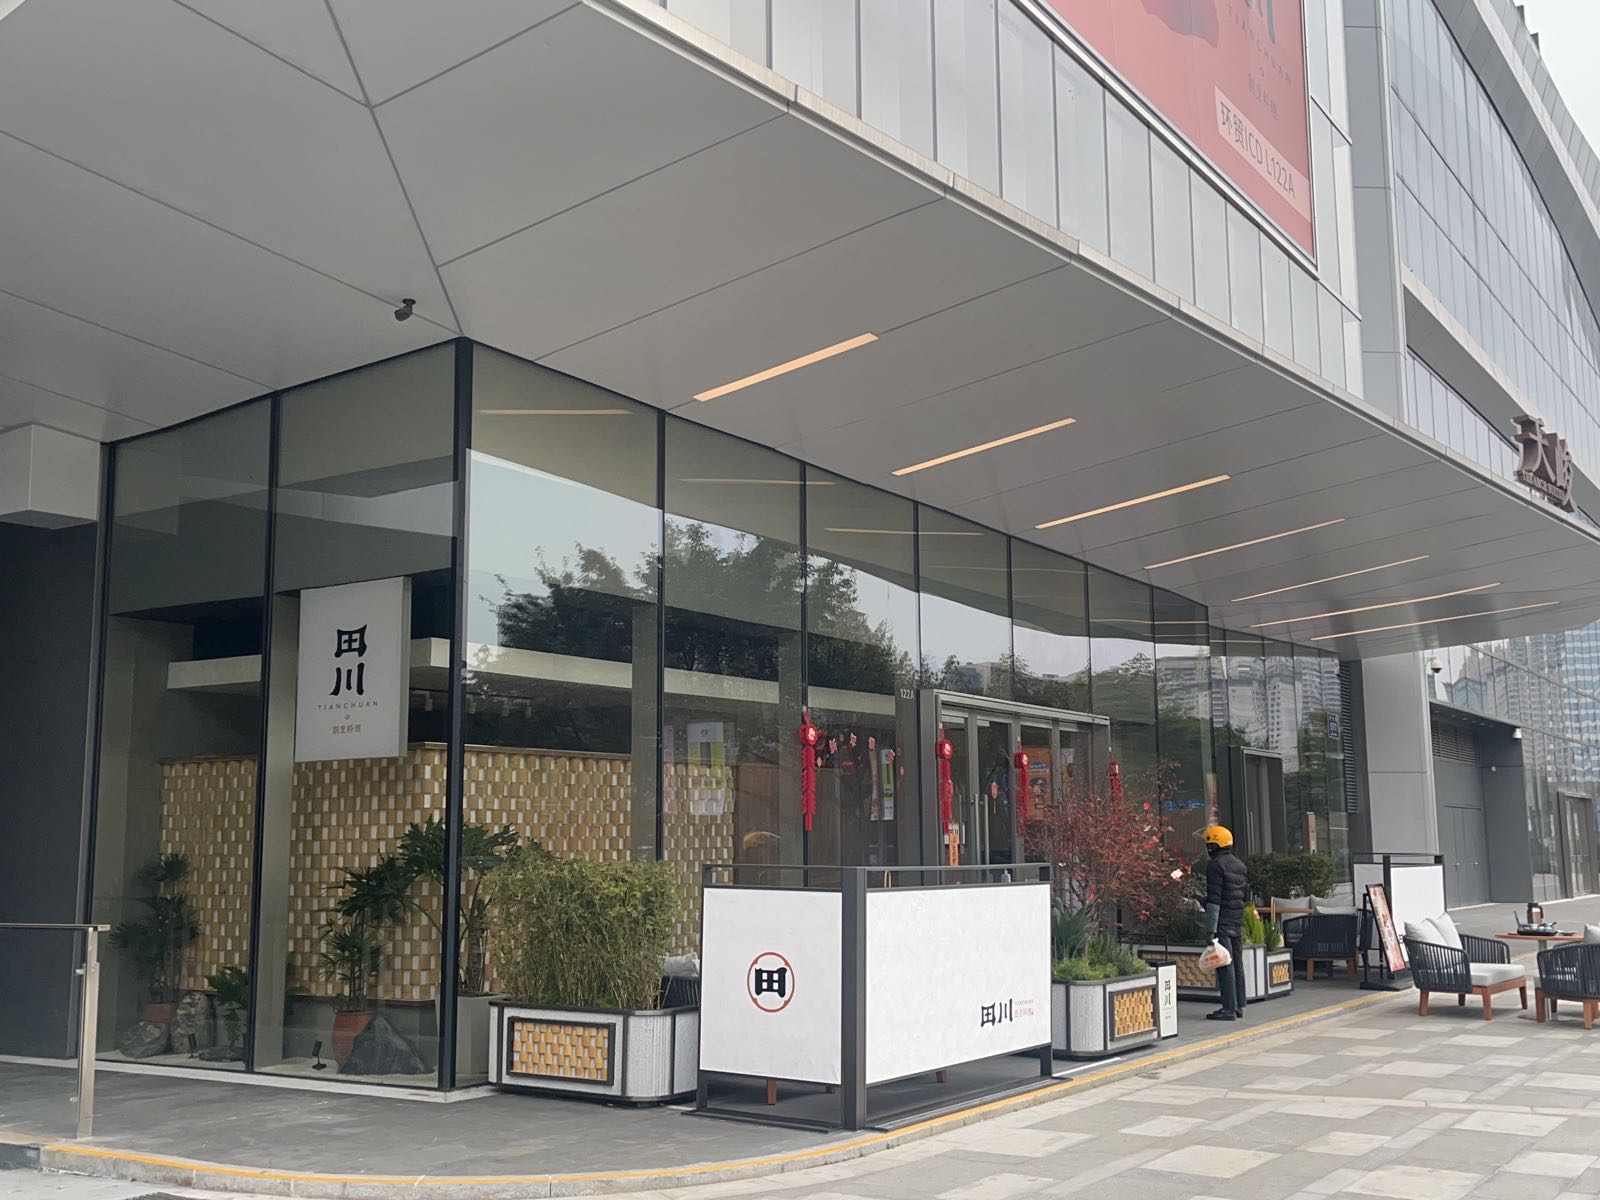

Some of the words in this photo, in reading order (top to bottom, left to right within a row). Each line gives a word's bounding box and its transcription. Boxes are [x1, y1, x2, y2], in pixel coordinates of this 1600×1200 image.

[1264, 148, 1296, 200] L122A
[329, 624, 368, 696] 田川
[317, 700, 378, 711] TIANCHUAN
[754, 967, 788, 998] 田
[980, 998, 1013, 1028] 田川
